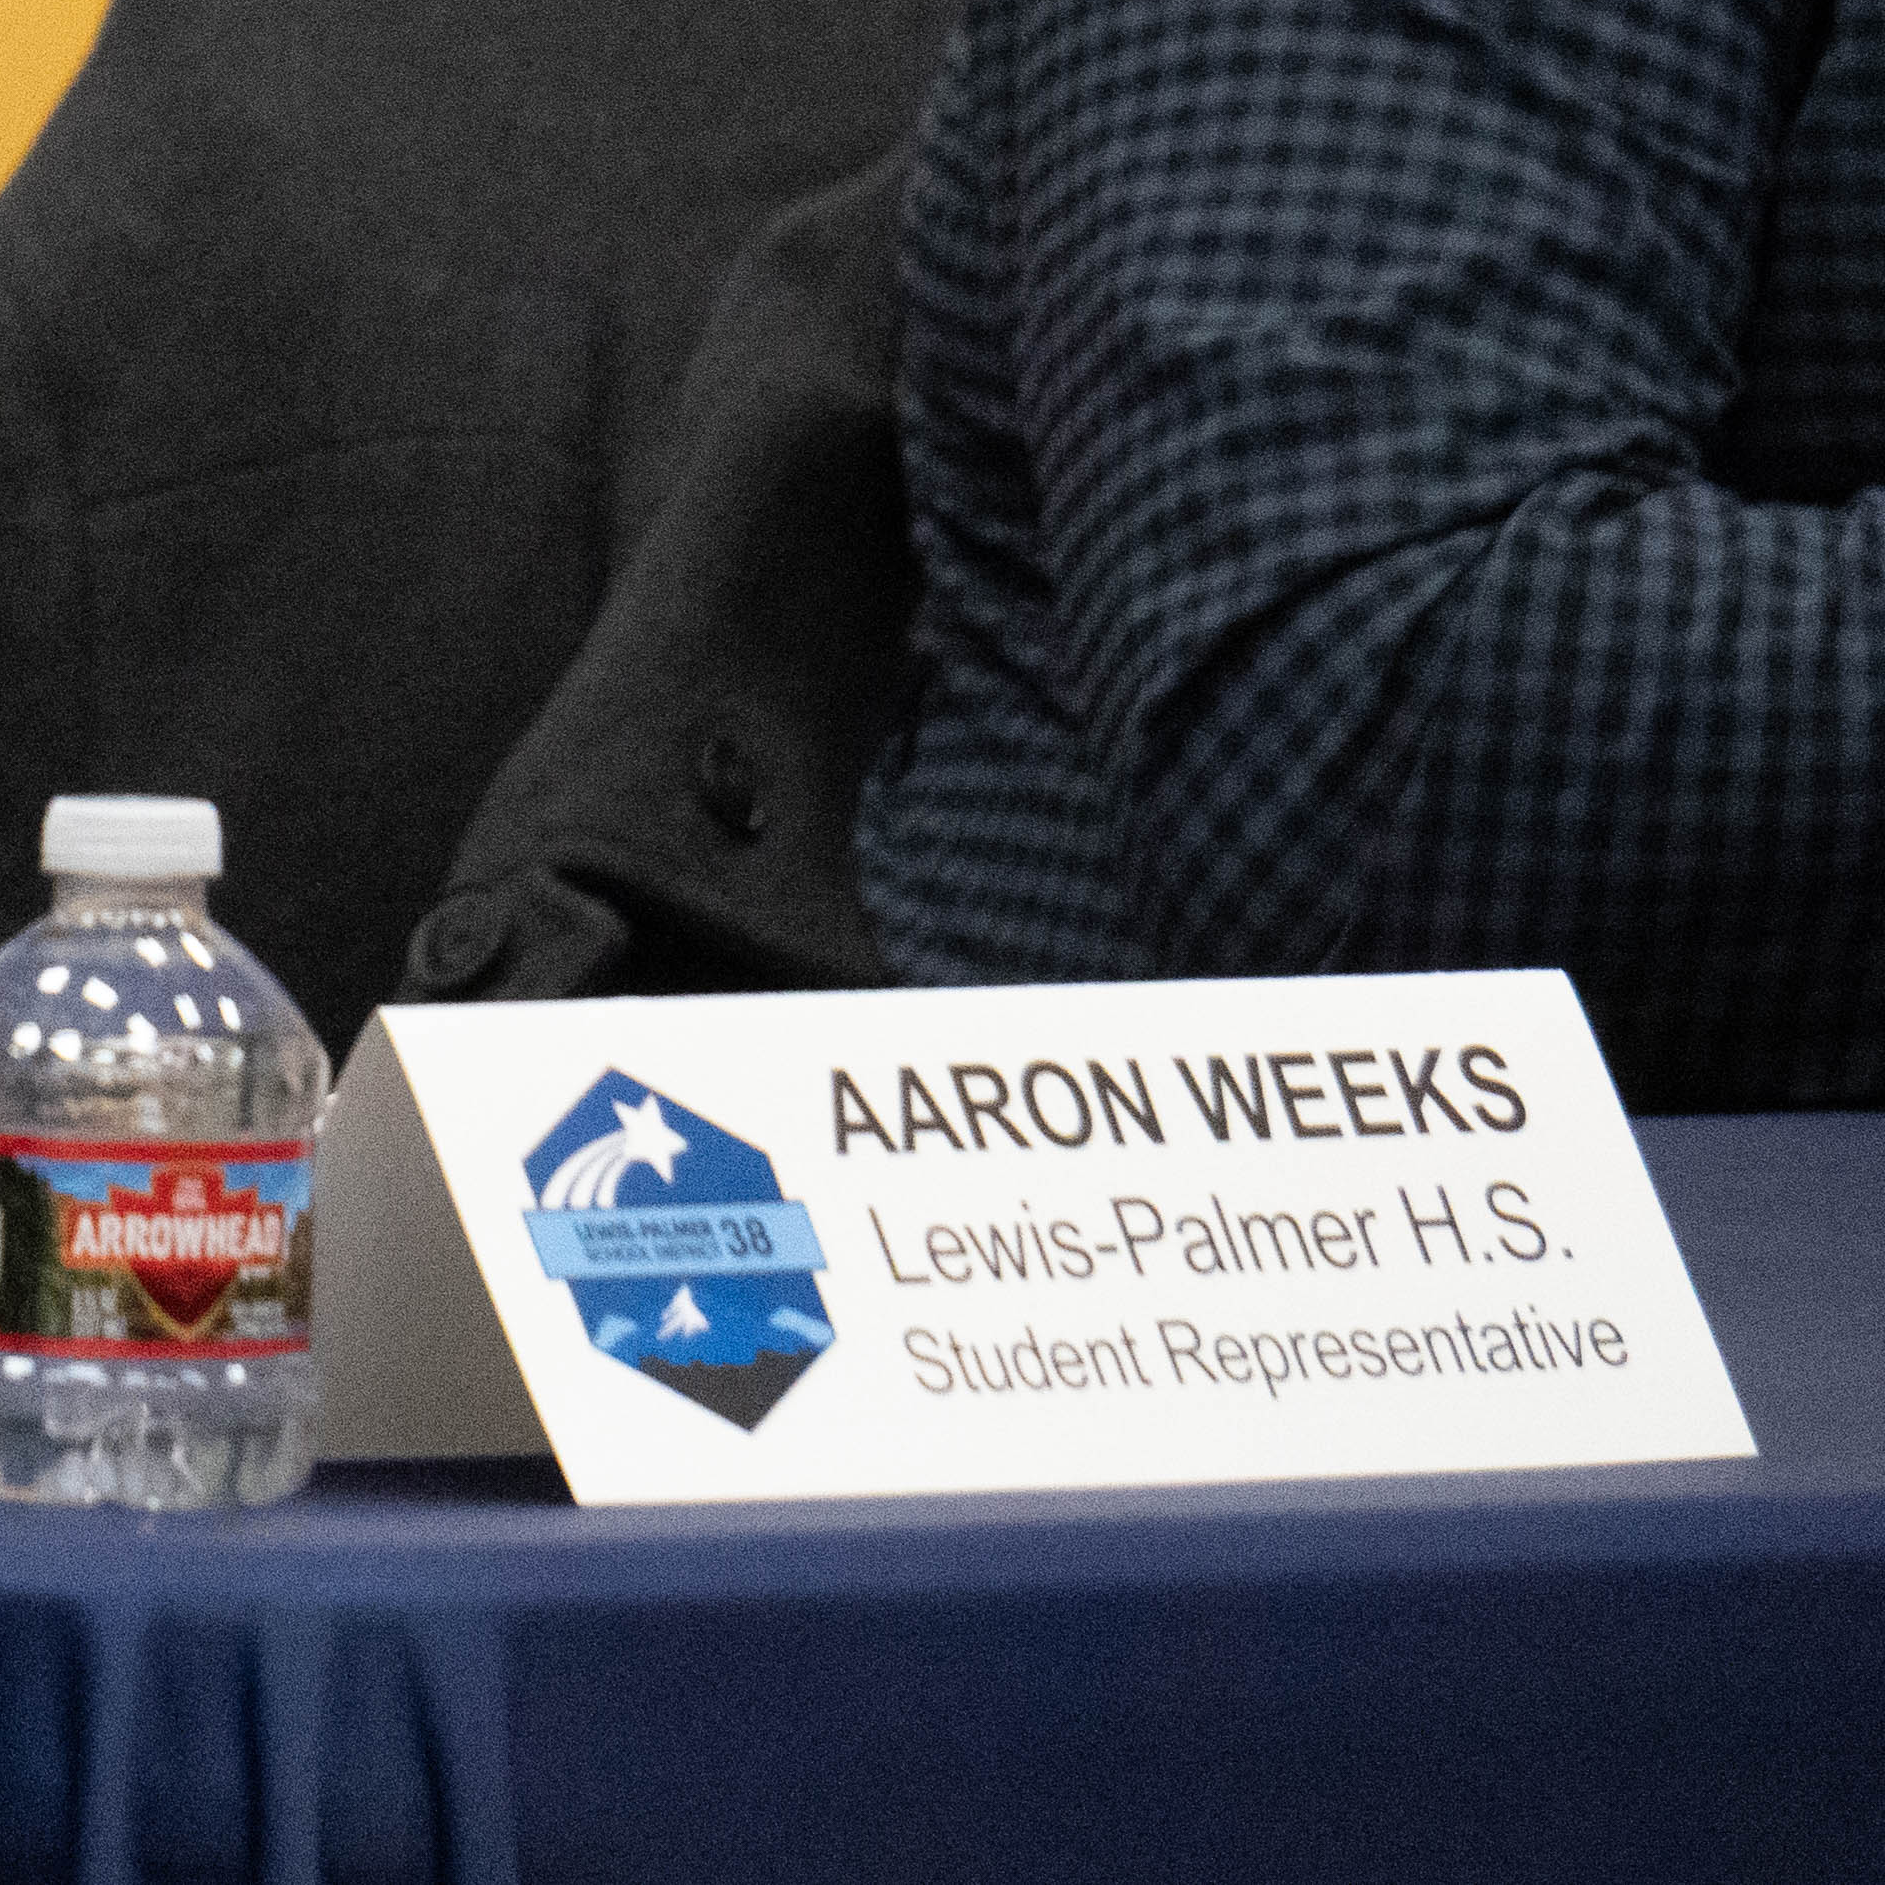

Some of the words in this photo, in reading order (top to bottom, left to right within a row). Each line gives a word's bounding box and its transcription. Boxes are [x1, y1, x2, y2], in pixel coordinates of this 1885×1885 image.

[831, 1058, 1166, 1156] AARON
[1173, 1044, 1528, 1143] WEEKS
[71, 1211, 281, 1261] ARROWHEAD
[719, 1216, 774, 1259] 38
[868, 1194, 1380, 1285] Lewis-Palmer
[1398, 1181, 1575, 1265] H.S.
[904, 1328, 1151, 1392] Student
[1157, 1305, 1629, 1399] Representative
